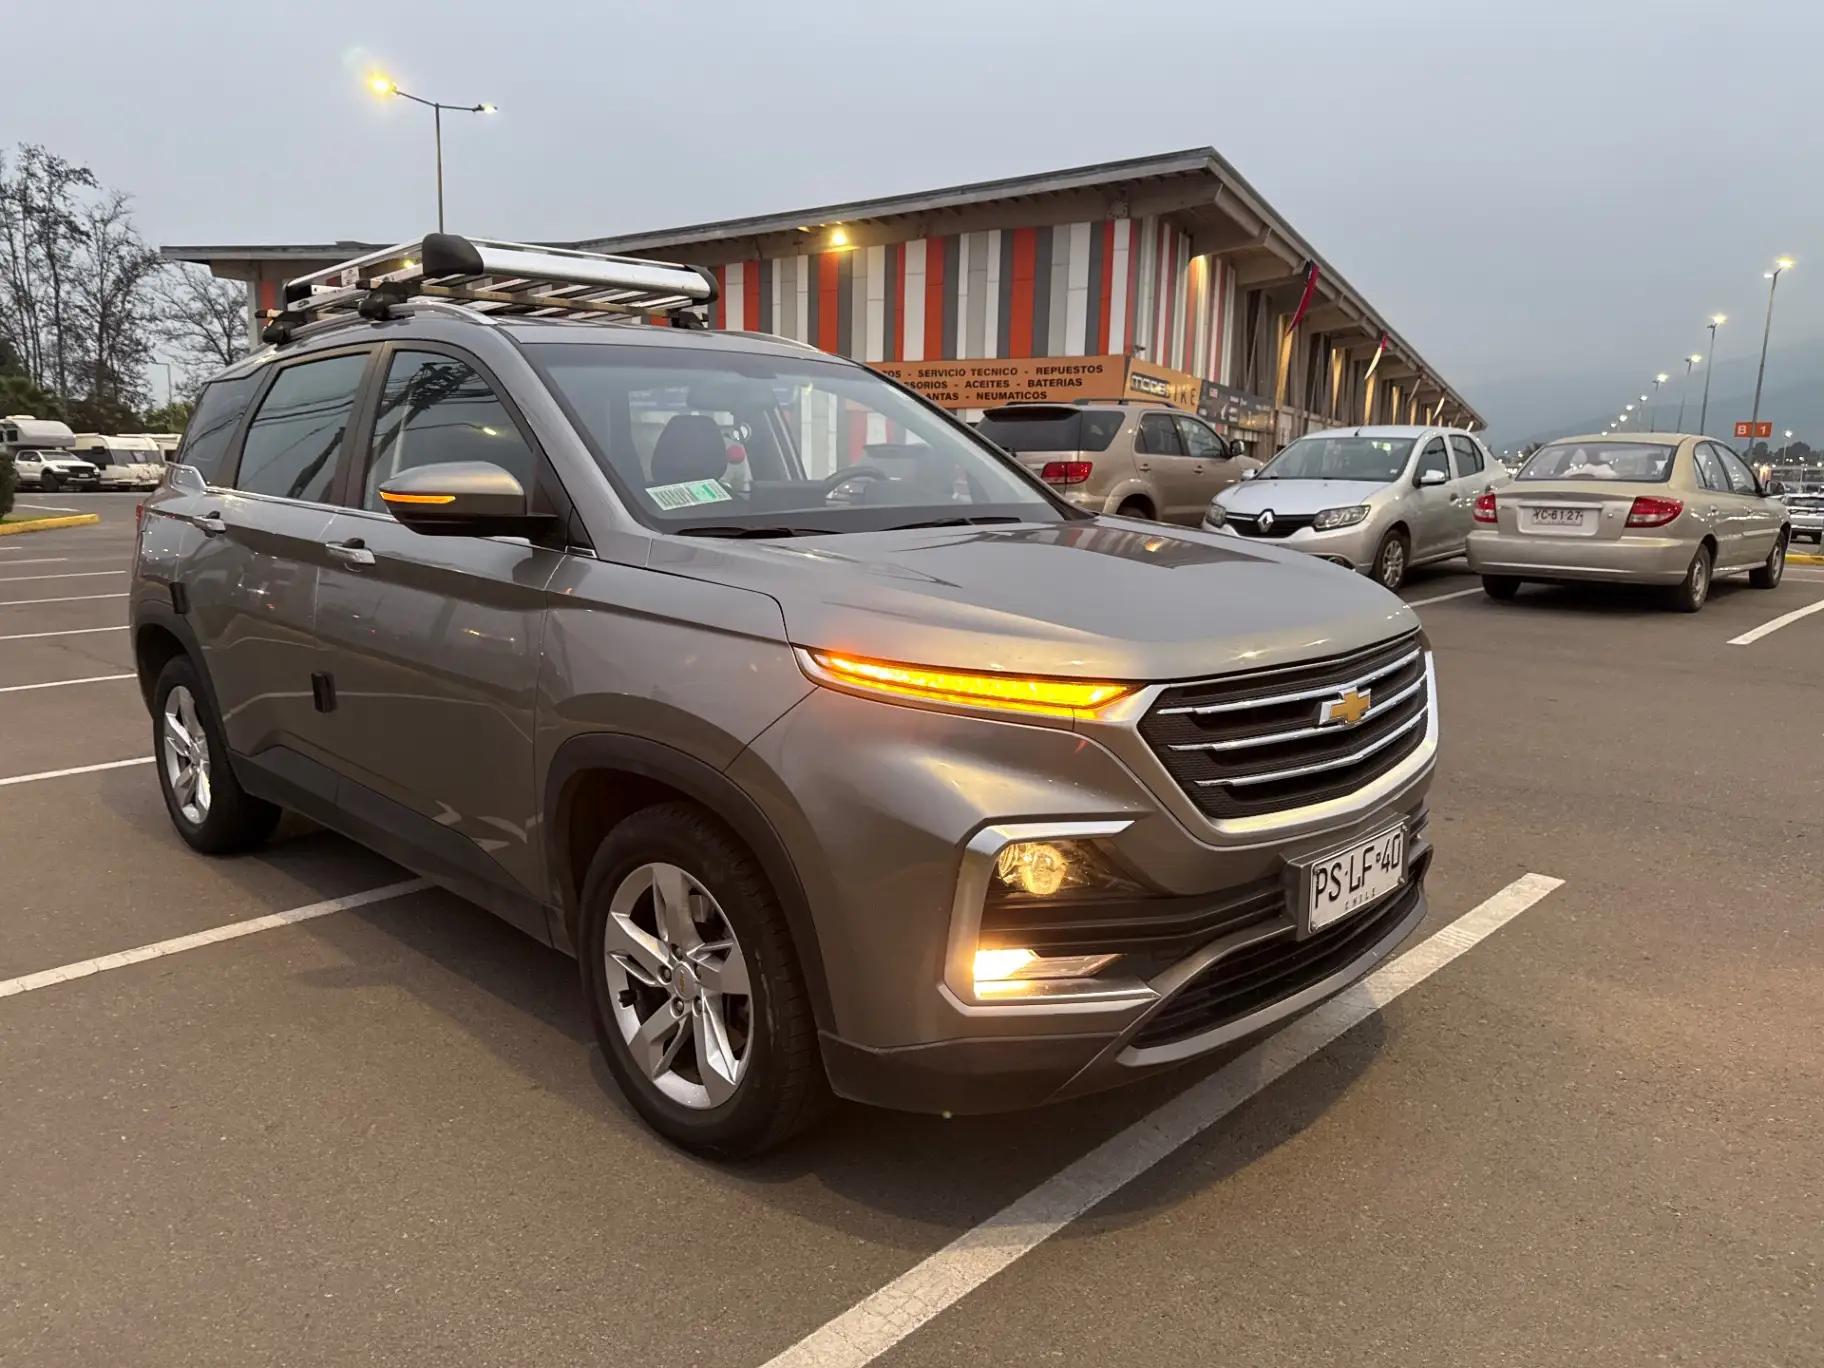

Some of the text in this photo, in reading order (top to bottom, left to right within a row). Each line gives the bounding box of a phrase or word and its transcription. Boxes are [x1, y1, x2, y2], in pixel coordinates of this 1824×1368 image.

[917, 368, 966, 378] SERVICIO
[971, 367, 1018, 377] TECNICO
[1036, 364, 1104, 375] REPUESTOS
[964, 379, 1010, 389] ACEITES
[1027, 377, 1083, 388] BATERIAS
[976, 391, 1048, 401] NEUMATICOS
[1737, 424, 1747, 435] B
